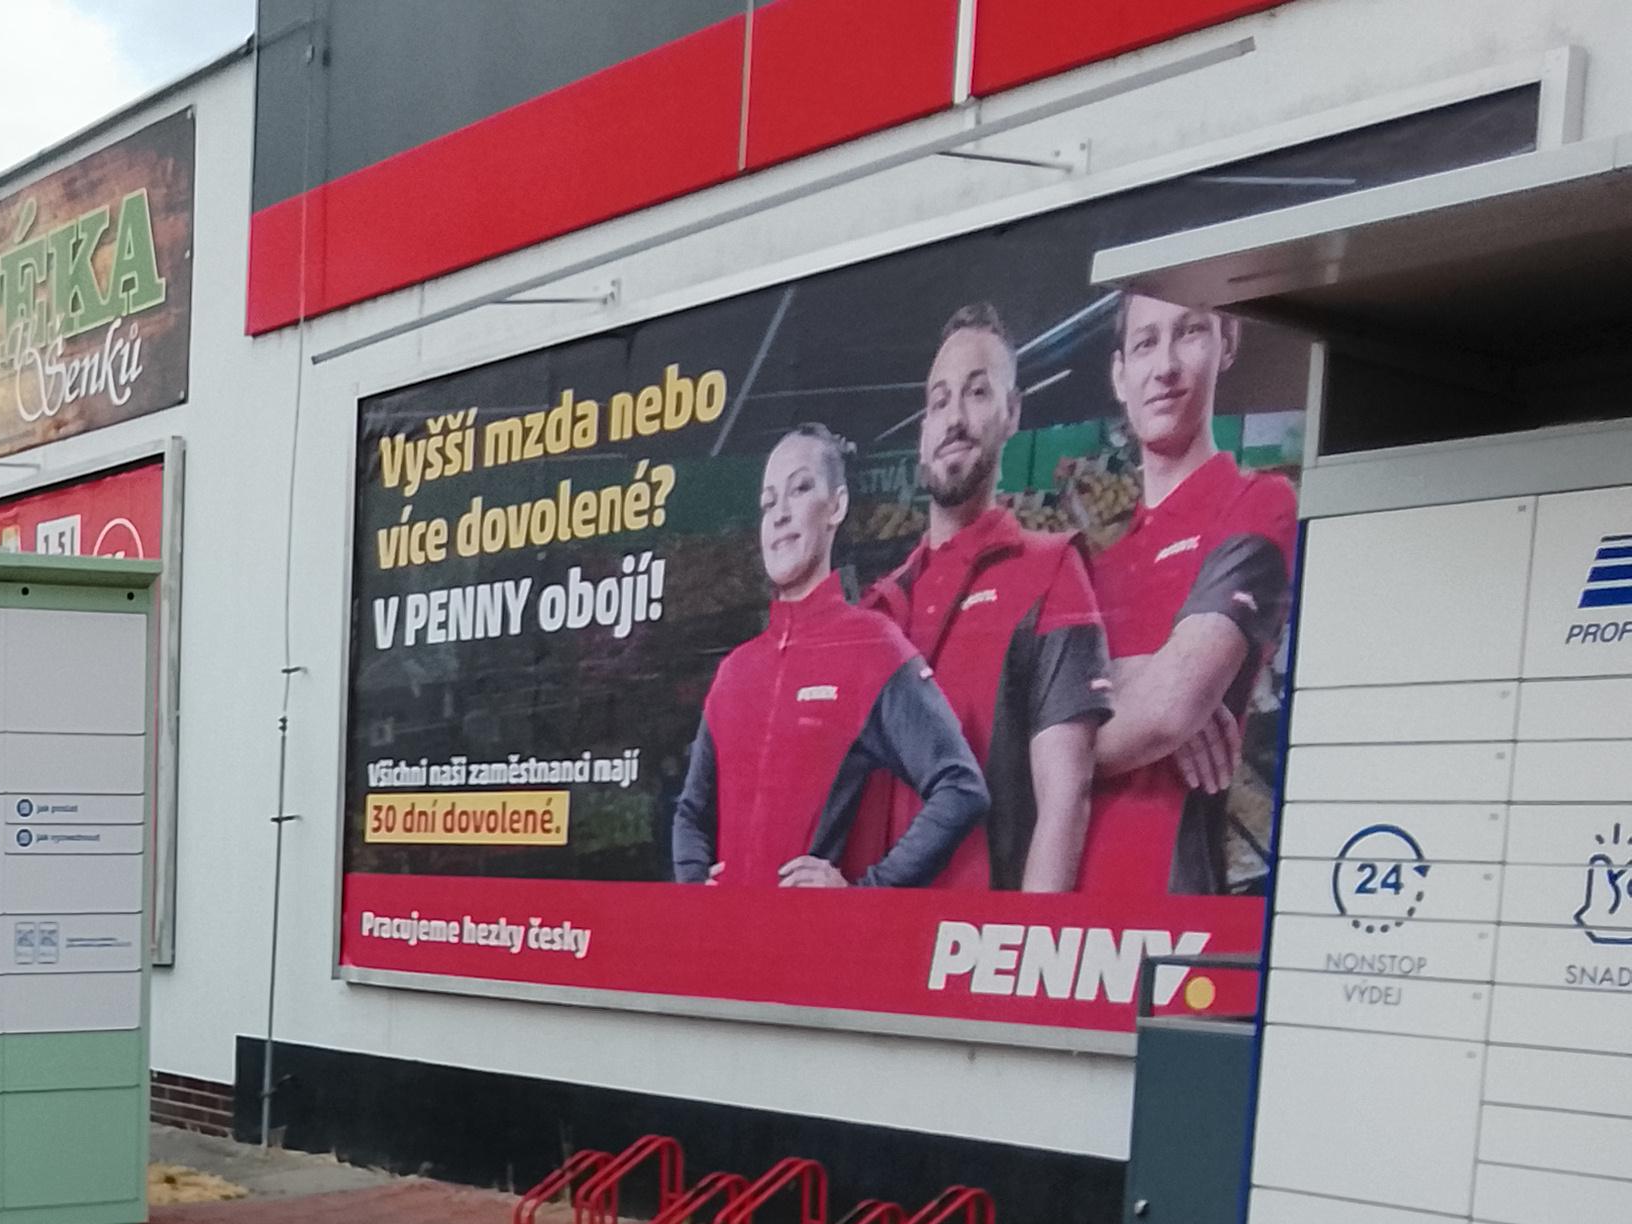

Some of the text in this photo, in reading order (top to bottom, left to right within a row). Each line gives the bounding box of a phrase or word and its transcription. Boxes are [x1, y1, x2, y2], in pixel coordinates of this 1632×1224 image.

[379, 363, 728, 497] Vyšší mzda nebo
[377, 459, 676, 570] více dovolené?
[373, 551, 666, 649] V PENNY obojí!
[368, 748, 641, 788] Všichni naši zaměstnanci mají
[371, 797, 561, 835] 30 dní dovolené.
[1355, 862, 1404, 895] 24
[361, 911, 592, 959] Pracujeme hezky česky
[1325, 952, 1427, 974] NONSTOP
